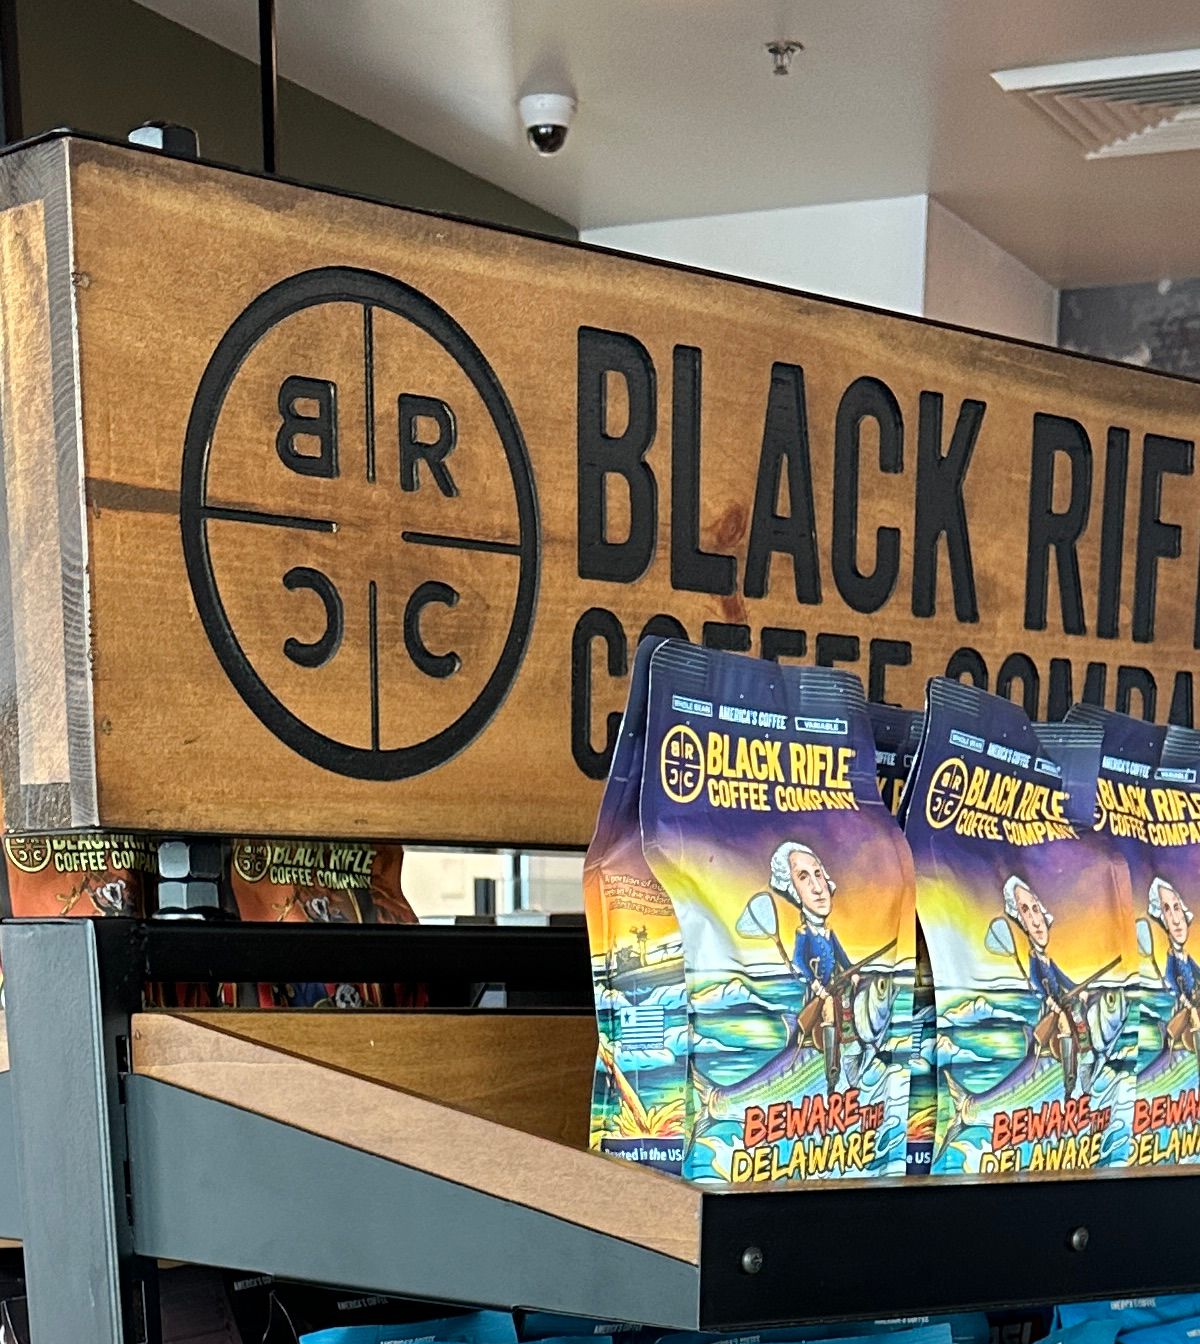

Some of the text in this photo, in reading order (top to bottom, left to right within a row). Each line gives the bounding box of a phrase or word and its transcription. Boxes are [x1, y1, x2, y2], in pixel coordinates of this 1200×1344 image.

[576, 326, 1200, 644] BLACK RIF
[719, 705, 787, 730] AMERICA'S COFFEE
[707, 731, 855, 789] BLACK RIFLE
[1011, 749, 1031, 769] COFFEE
[1129, 761, 1152, 779] COFFEE
[707, 778, 771, 811] COFFEE
[775, 785, 860, 812] COMPANY
[966, 766, 1068, 824] BLACK RIFLE
[1096, 777, 1153, 822] BLACK
[956, 808, 1080, 847] COFFEE COMPANY
[1111, 811, 1200, 847] COFFEE COMPA
[54, 852, 158, 875] COFFEE COMPAN
[270, 866, 372, 890] COFFEE COMPANY
[273, 846, 377, 874] BLACK RIFLE
[744, 1087, 884, 1149] BEWARE THE
[991, 1095, 1111, 1149] BEWARE THE
[650, 1148, 666, 1161] the
[731, 1130, 878, 1183] DELAWARE
[915, 1152, 931, 1164] US
[980, 1132, 1102, 1173] DELAWARE
